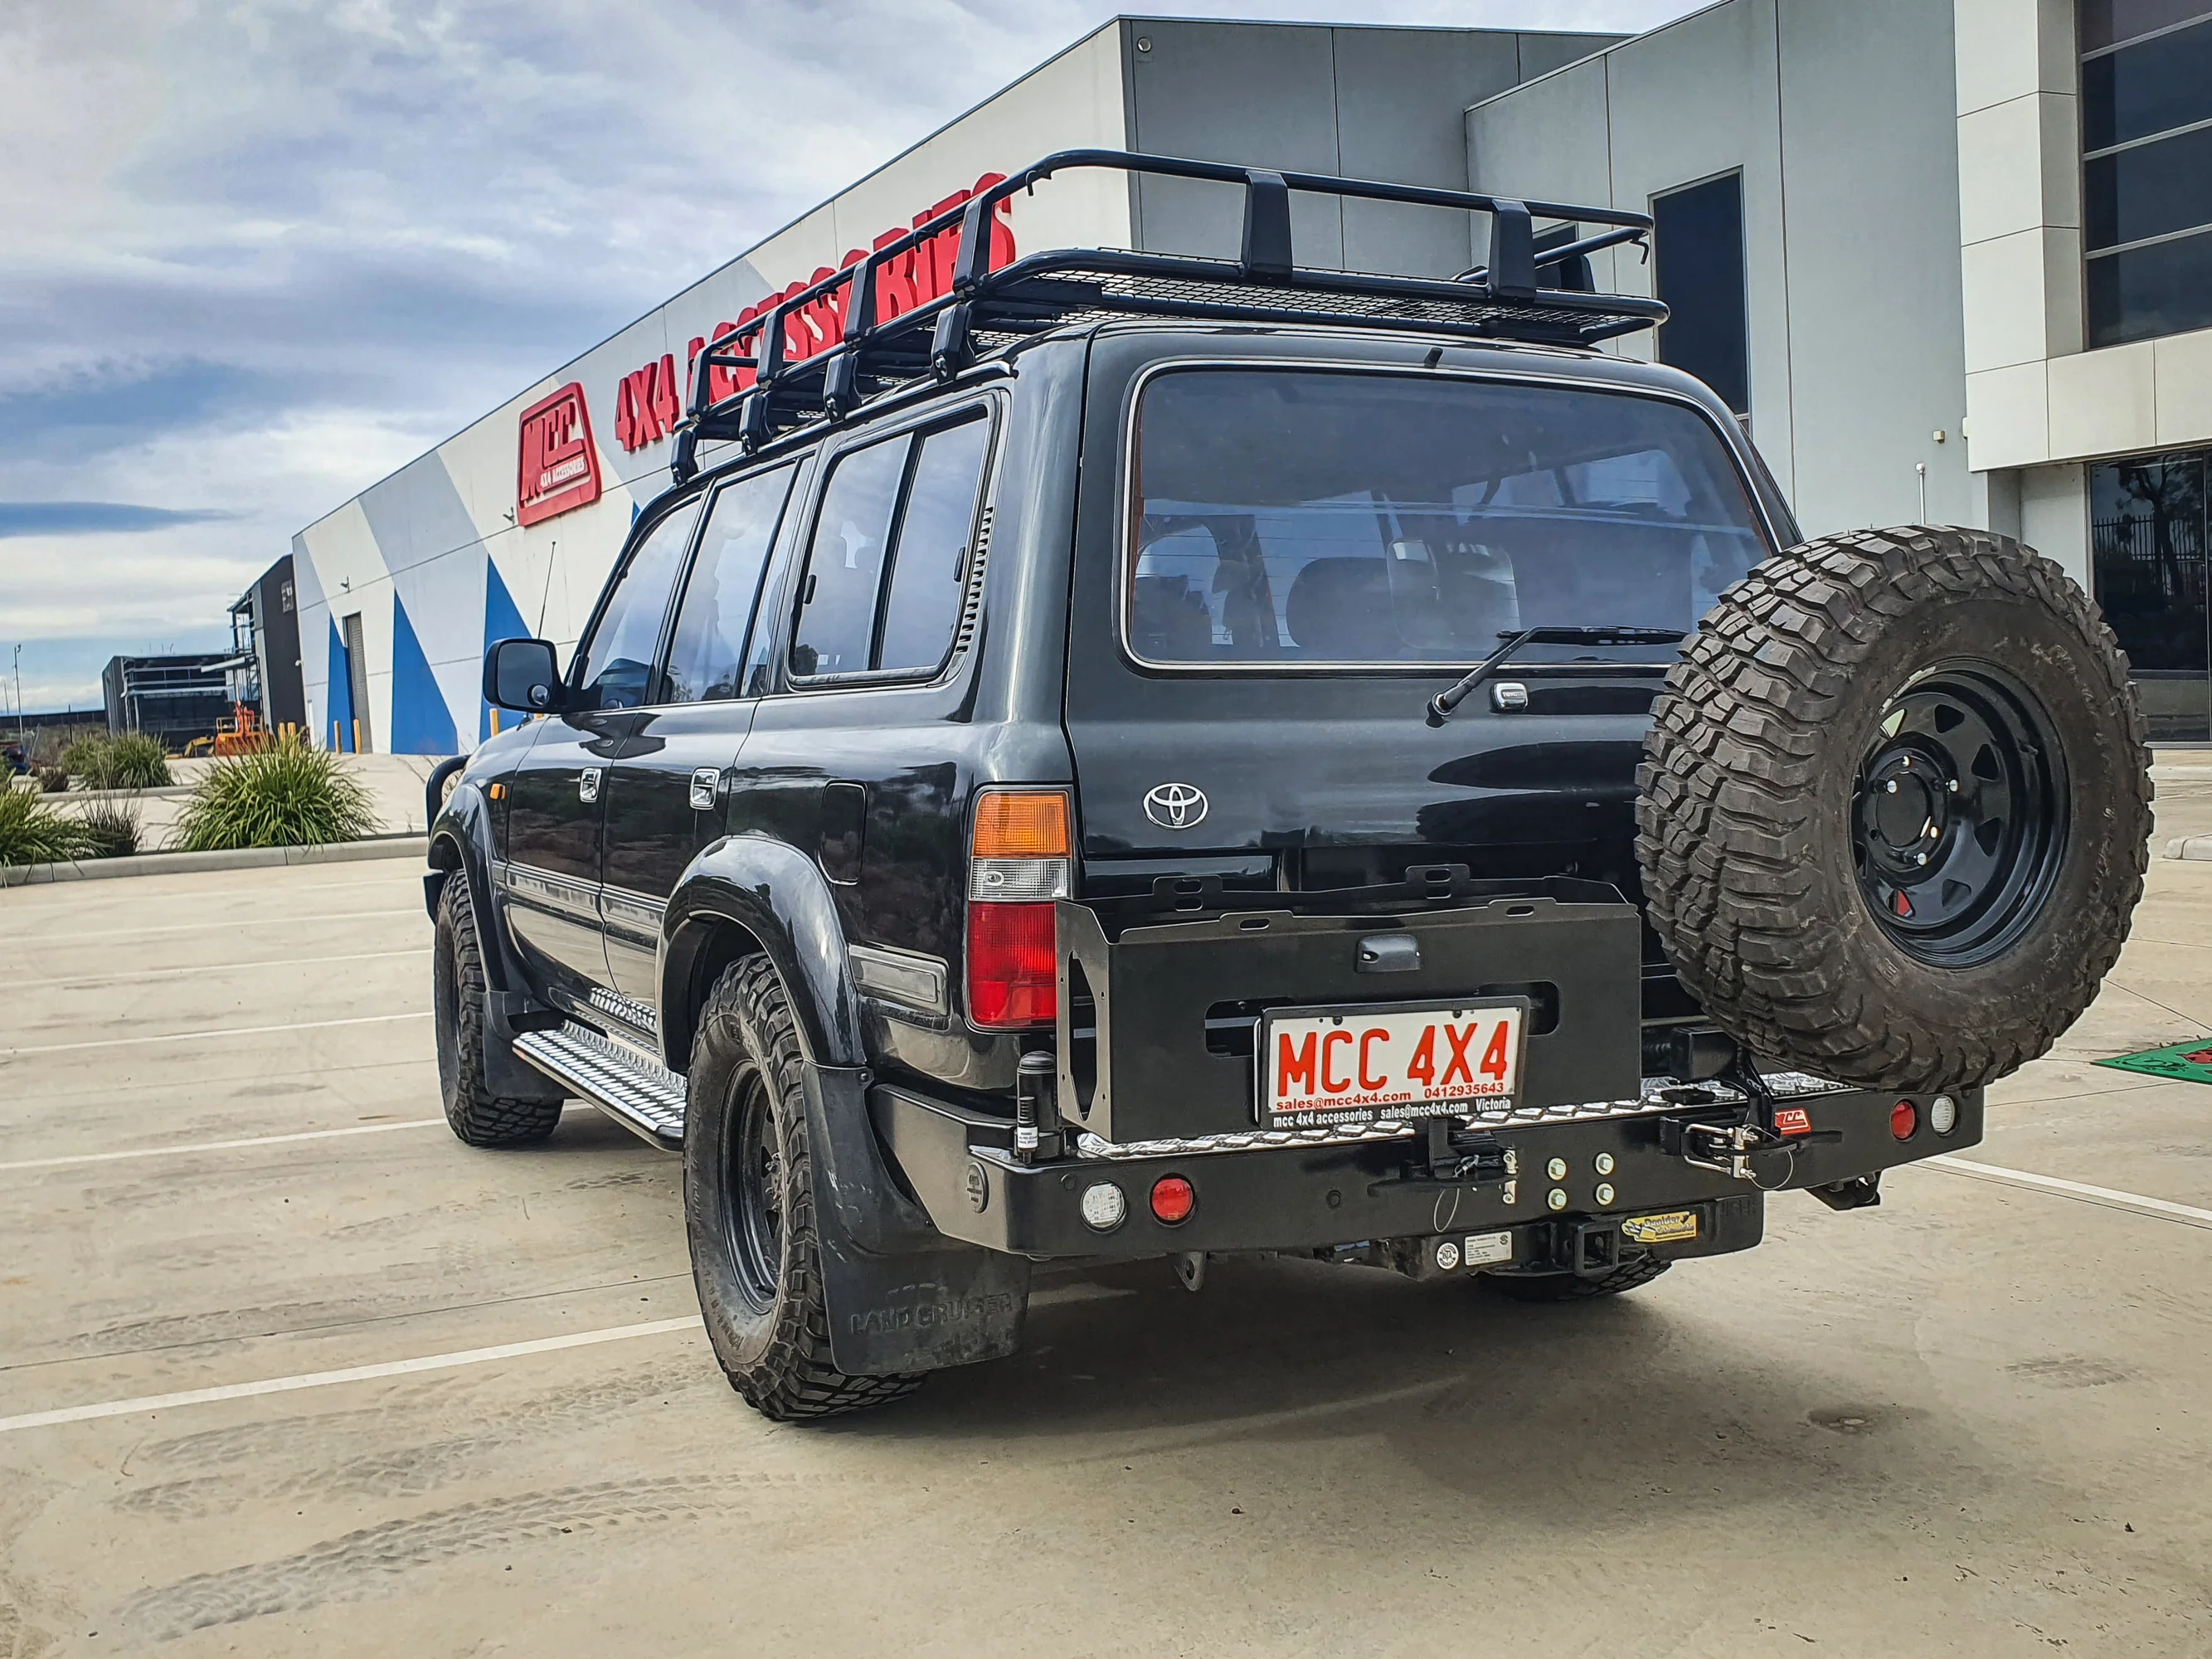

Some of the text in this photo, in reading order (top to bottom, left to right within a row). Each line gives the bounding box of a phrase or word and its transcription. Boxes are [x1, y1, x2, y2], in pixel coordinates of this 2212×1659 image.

[615, 353, 679, 452] 4X4
[520, 401, 586, 502] MCC
[1277, 1020, 1509, 1097] MCC 4X4
[1273, 1096, 1511, 1128] mcc 4x4 accessories sales@mcc4x4.com Victoria
[1276, 1092, 1412, 1111] sales@mcc4x4.com
[1423, 1082, 1505, 1099] 0412935643
